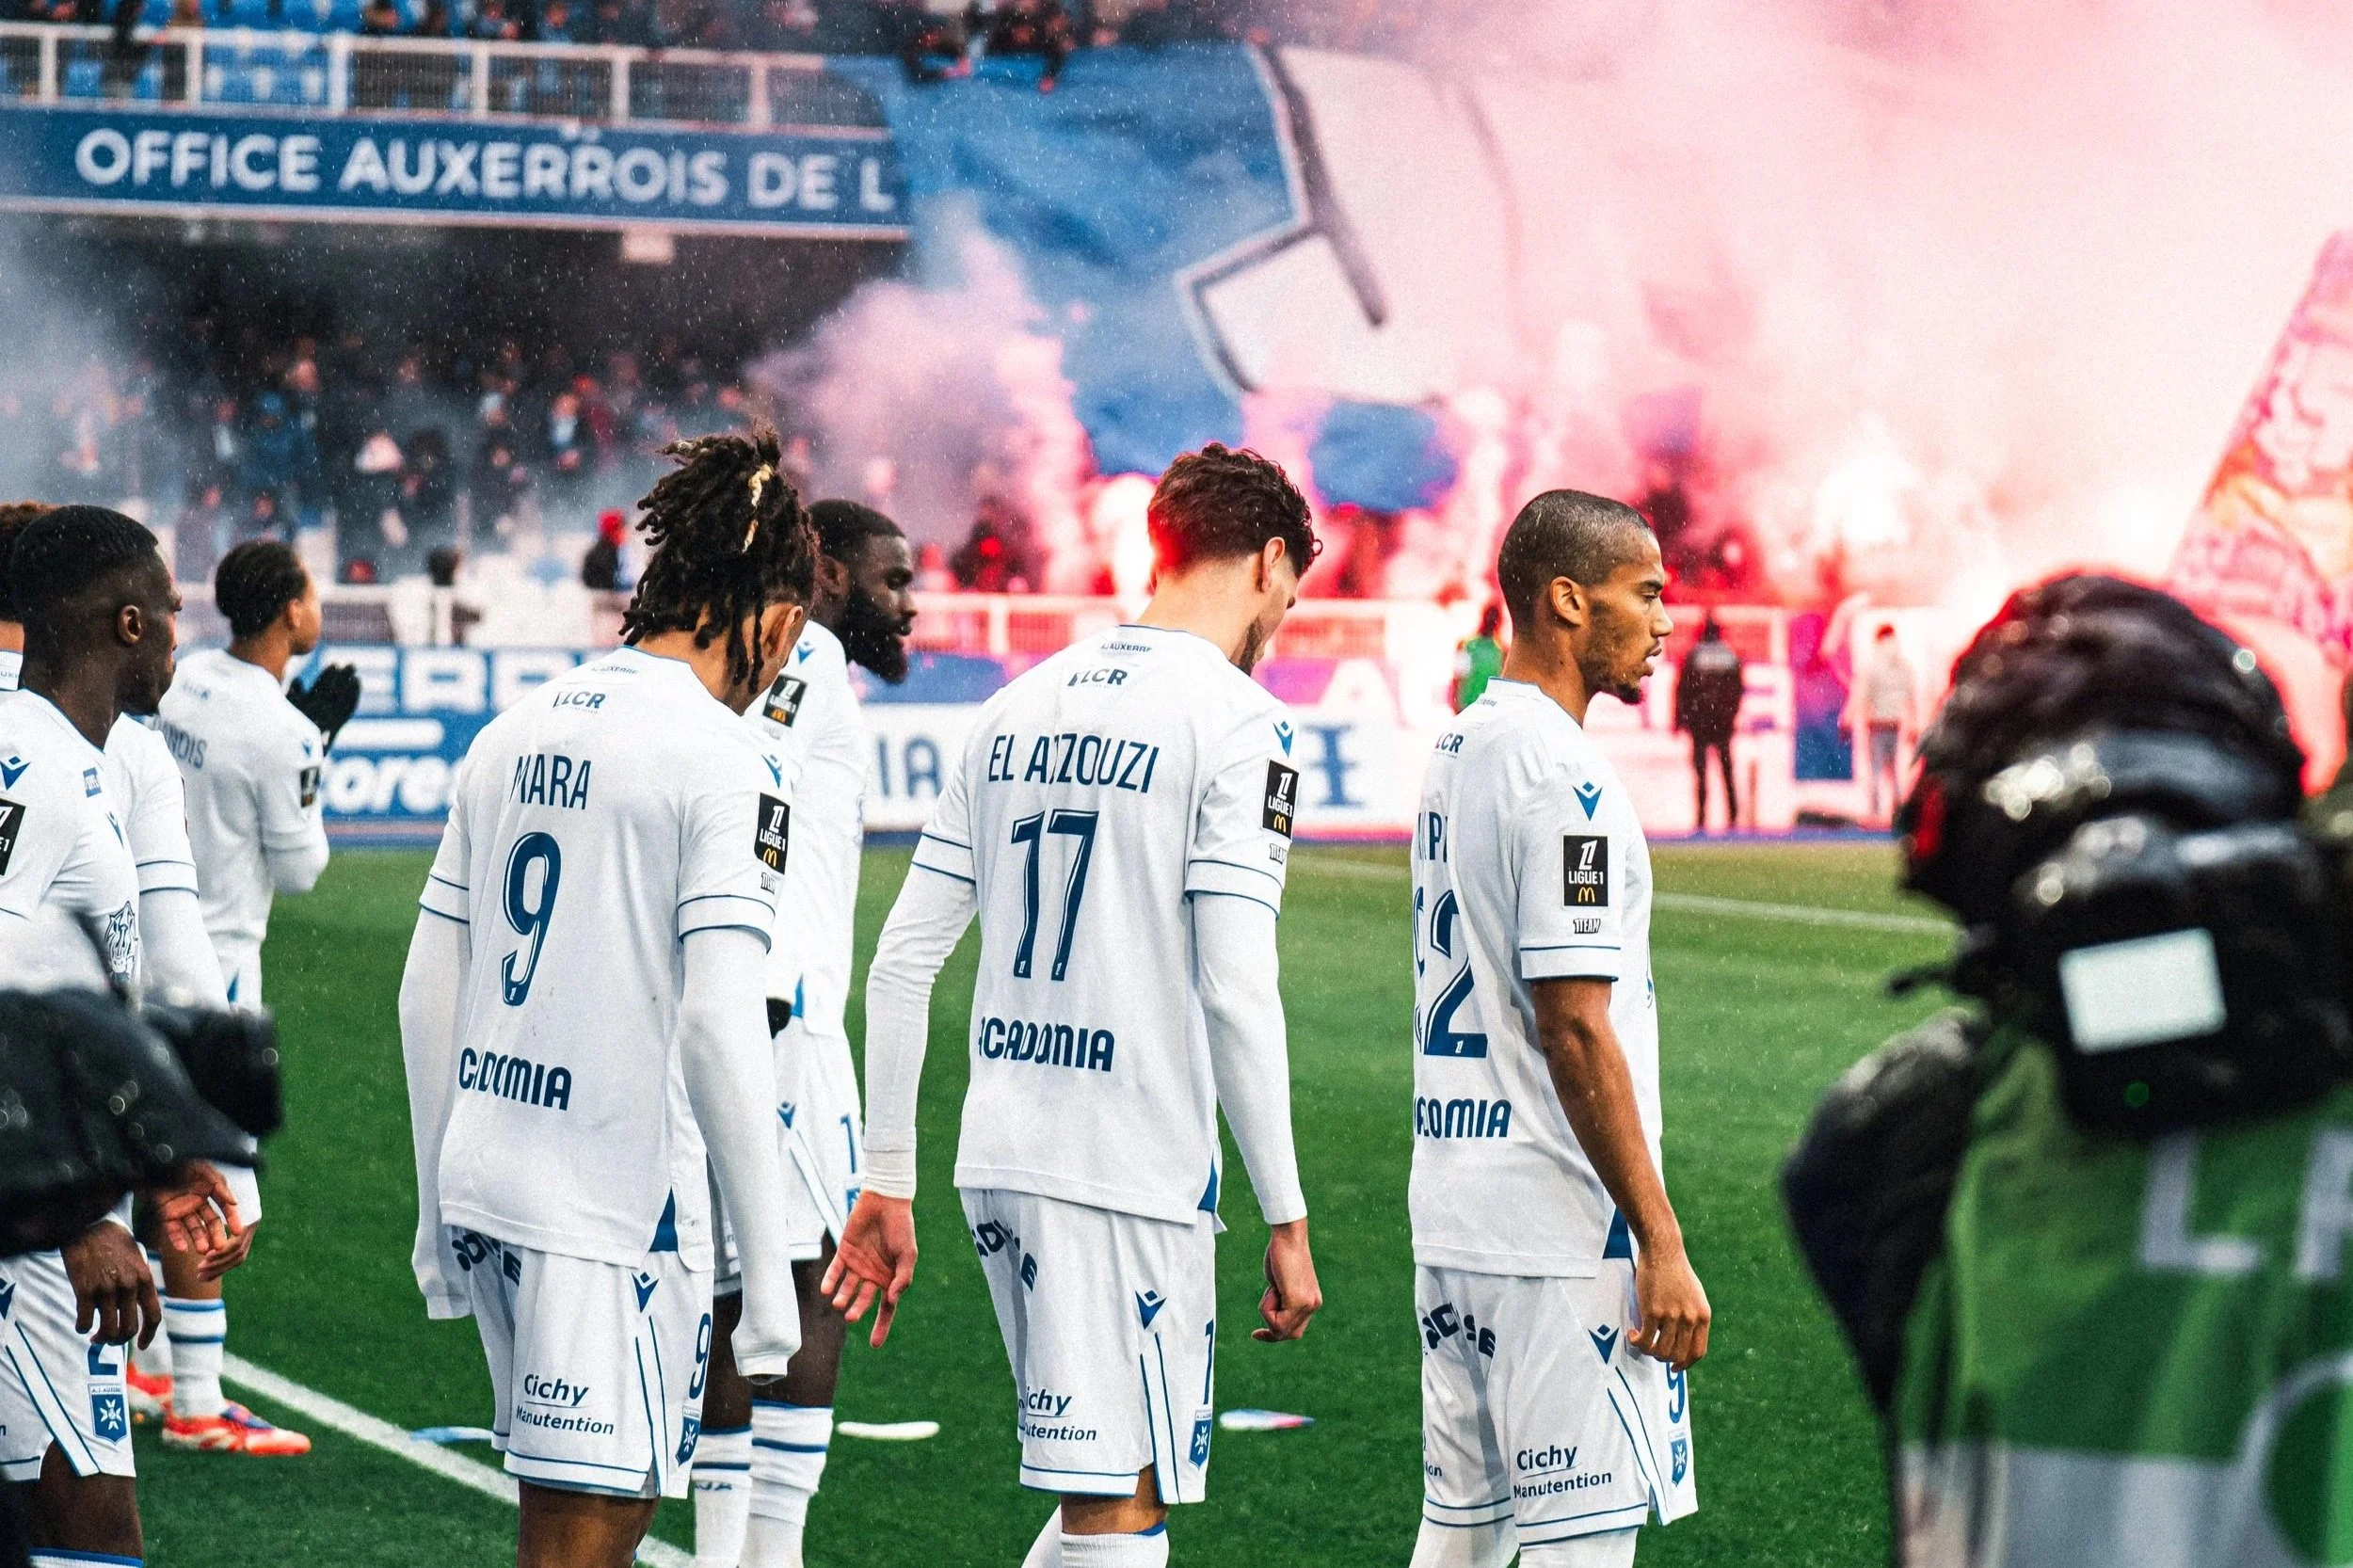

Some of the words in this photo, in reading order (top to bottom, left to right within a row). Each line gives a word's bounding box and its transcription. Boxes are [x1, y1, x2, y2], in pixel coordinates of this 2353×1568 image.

[74, 127, 322, 192] OFFICE
[338, 136, 730, 207] AUXERROIS
[747, 152, 840, 211] DE
[988, 734, 1016, 782] EL
[1267, 794, 1290, 816] LIGUE
[759, 827, 783, 851] LIGUE
[1568, 870, 1598, 885] LIGUE
[1011, 808, 1099, 982] 17
[501, 831, 562, 1008] 9
[979, 1016, 1115, 1072] CADOMIA
[689, 1312, 712, 1400] 9
[524, 1373, 590, 1407] Cichy
[1025, 1385, 1073, 1416] ichy
[516, 1404, 615, 1435] Manutention
[1516, 1445, 1578, 1471] Cichy
[1513, 1472, 1612, 1499] Manutention
